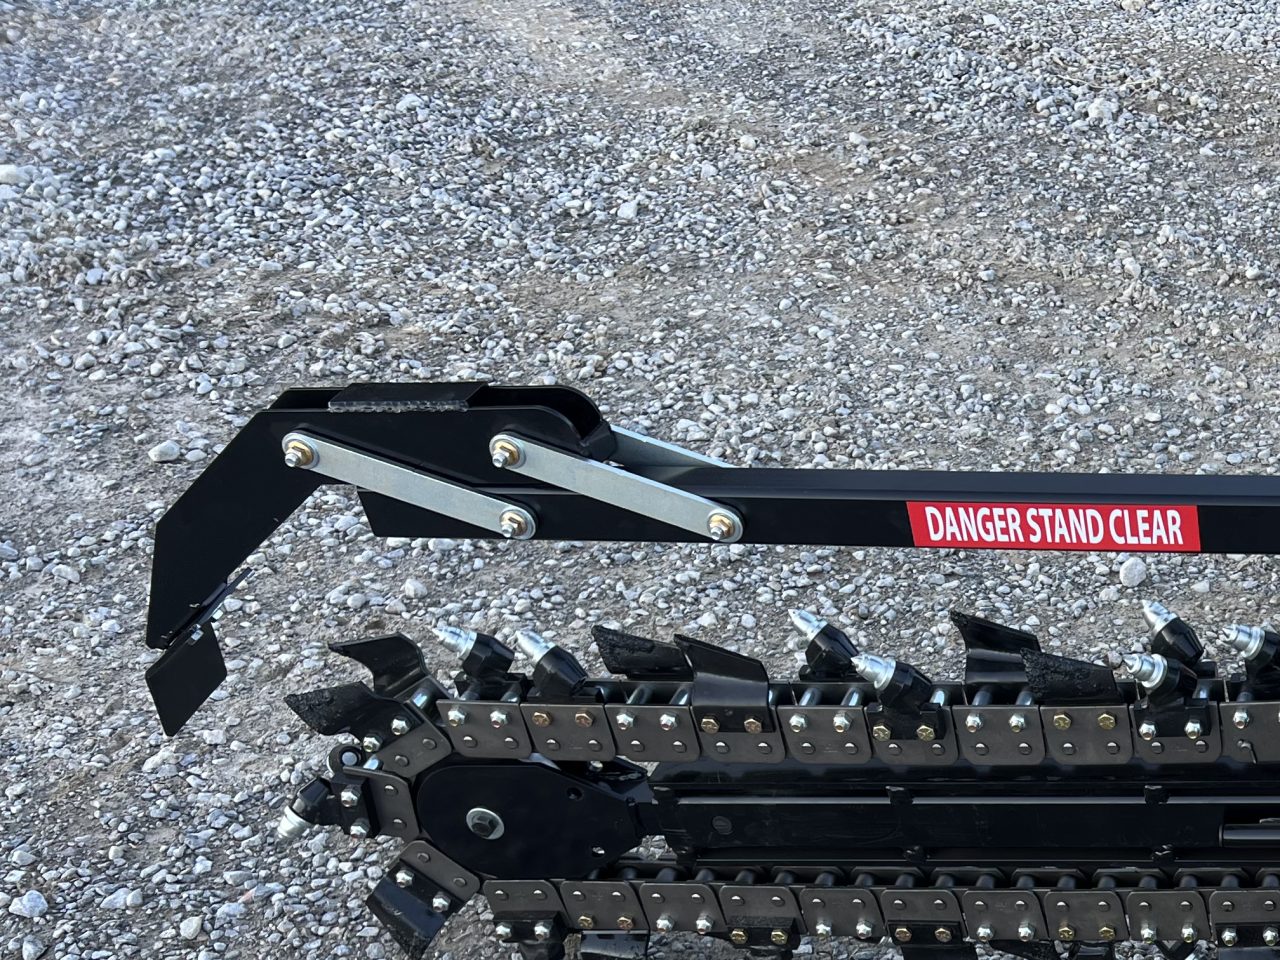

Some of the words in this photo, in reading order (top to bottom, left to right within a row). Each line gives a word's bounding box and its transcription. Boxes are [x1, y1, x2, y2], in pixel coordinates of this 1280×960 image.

[924, 506, 1025, 543] DANGER
[1026, 507, 1105, 544] STAND
[1109, 509, 1184, 545] CLEAR
